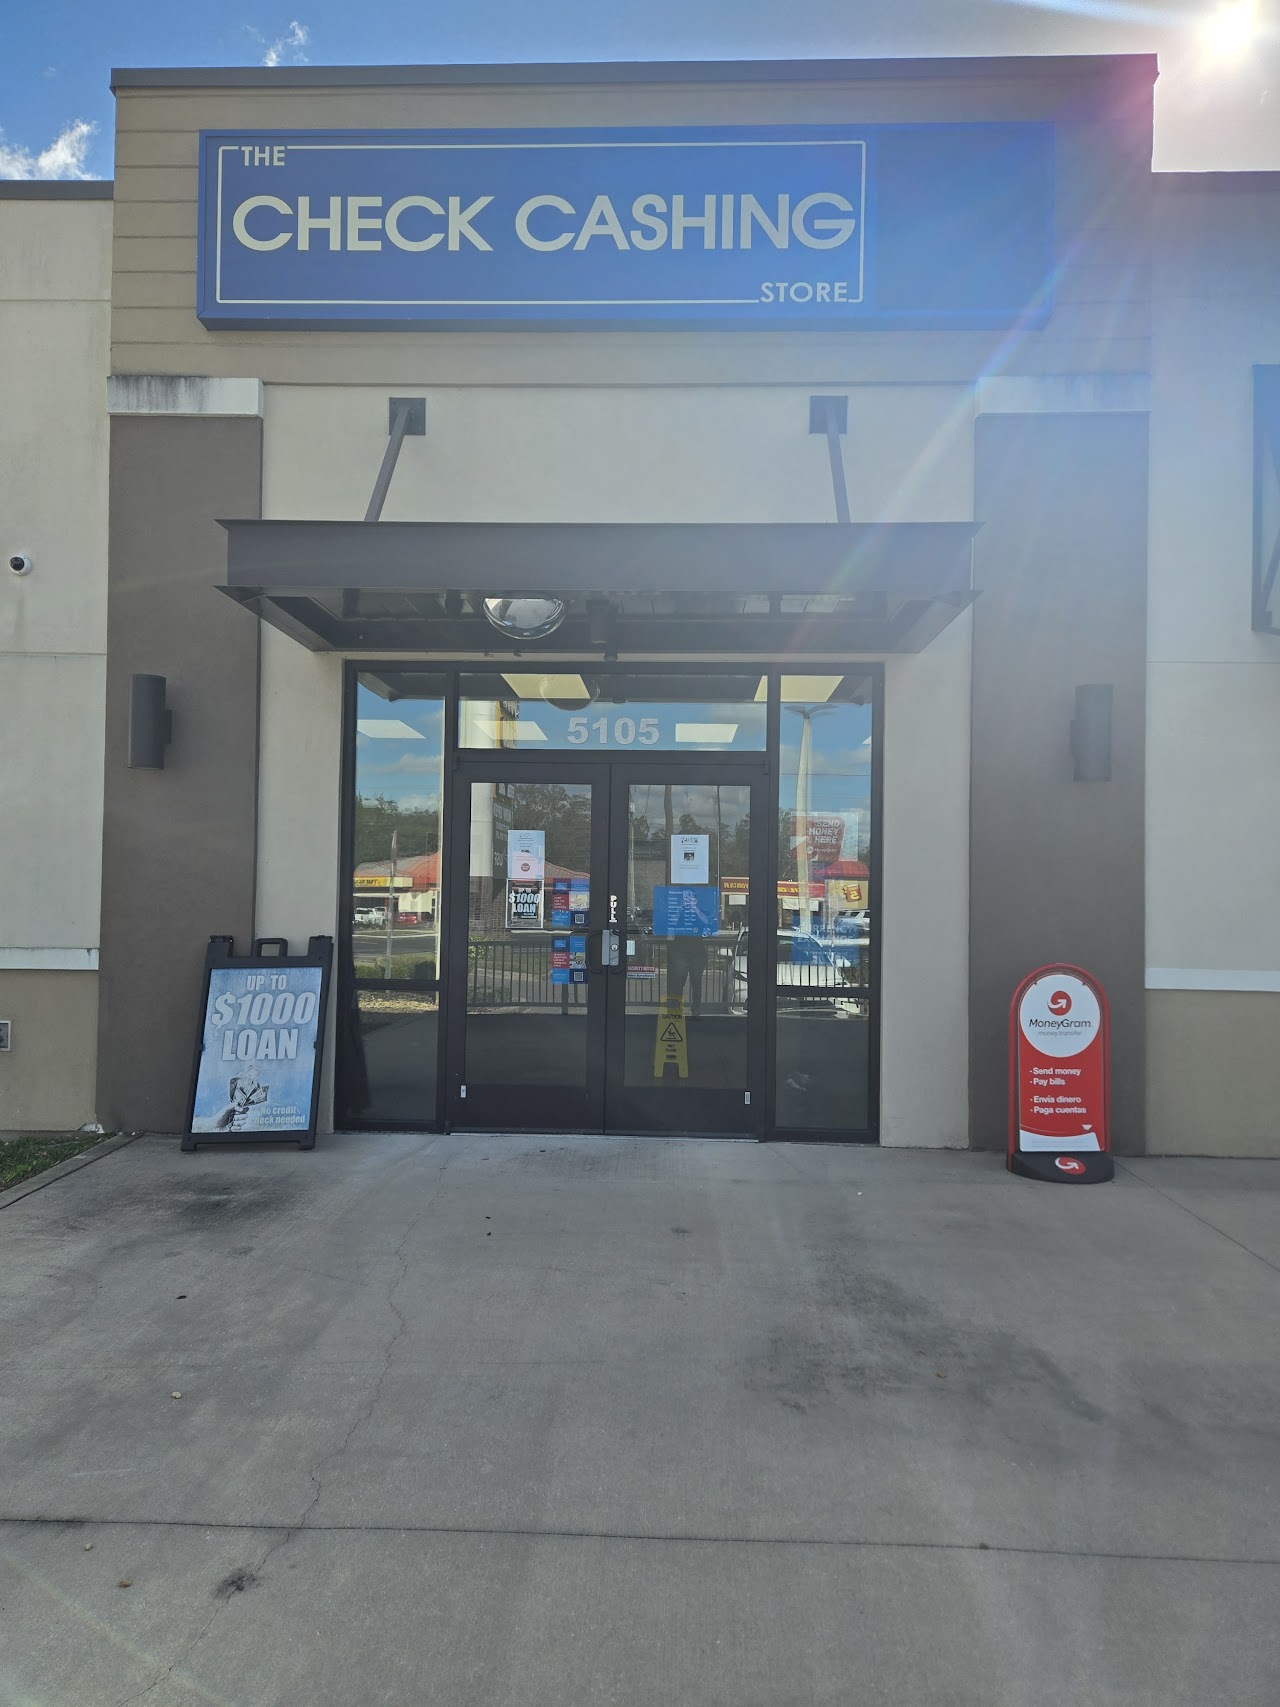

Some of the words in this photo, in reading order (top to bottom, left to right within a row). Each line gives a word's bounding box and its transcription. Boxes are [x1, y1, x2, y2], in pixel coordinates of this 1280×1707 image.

[241, 146, 286, 167] THE
[232, 195, 496, 252] CHECK
[515, 192, 856, 252] CASHING
[759, 282, 848, 304] STORE
[567, 717, 660, 745] 5105
[816, 819, 840, 828] SEND
[808, 827, 839, 836] MONEY
[814, 835, 838, 844] HERE
[508, 892, 541, 904] $1000
[512, 903, 537, 913] LOAN
[608, 894, 618, 923] PULL
[247, 975, 265, 991] UP
[270, 974, 287, 990] TO
[211, 991, 317, 1030] $1000
[1028, 1018, 1092, 1030] MoneyGram
[221, 1028, 299, 1062] LOAN
[1033, 1067, 1053, 1075] Send
[1054, 1068, 1081, 1077] money
[1033, 1077, 1048, 1087] Pay
[1049, 1077, 1066, 1085] bills
[1056, 1095, 1082, 1103] dinero
[272, 1105, 296, 1115] credit
[1033, 1106, 1054, 1115] Paga
[1055, 1106, 1087, 1114] cuentas
[275, 1114, 306, 1124] needed
